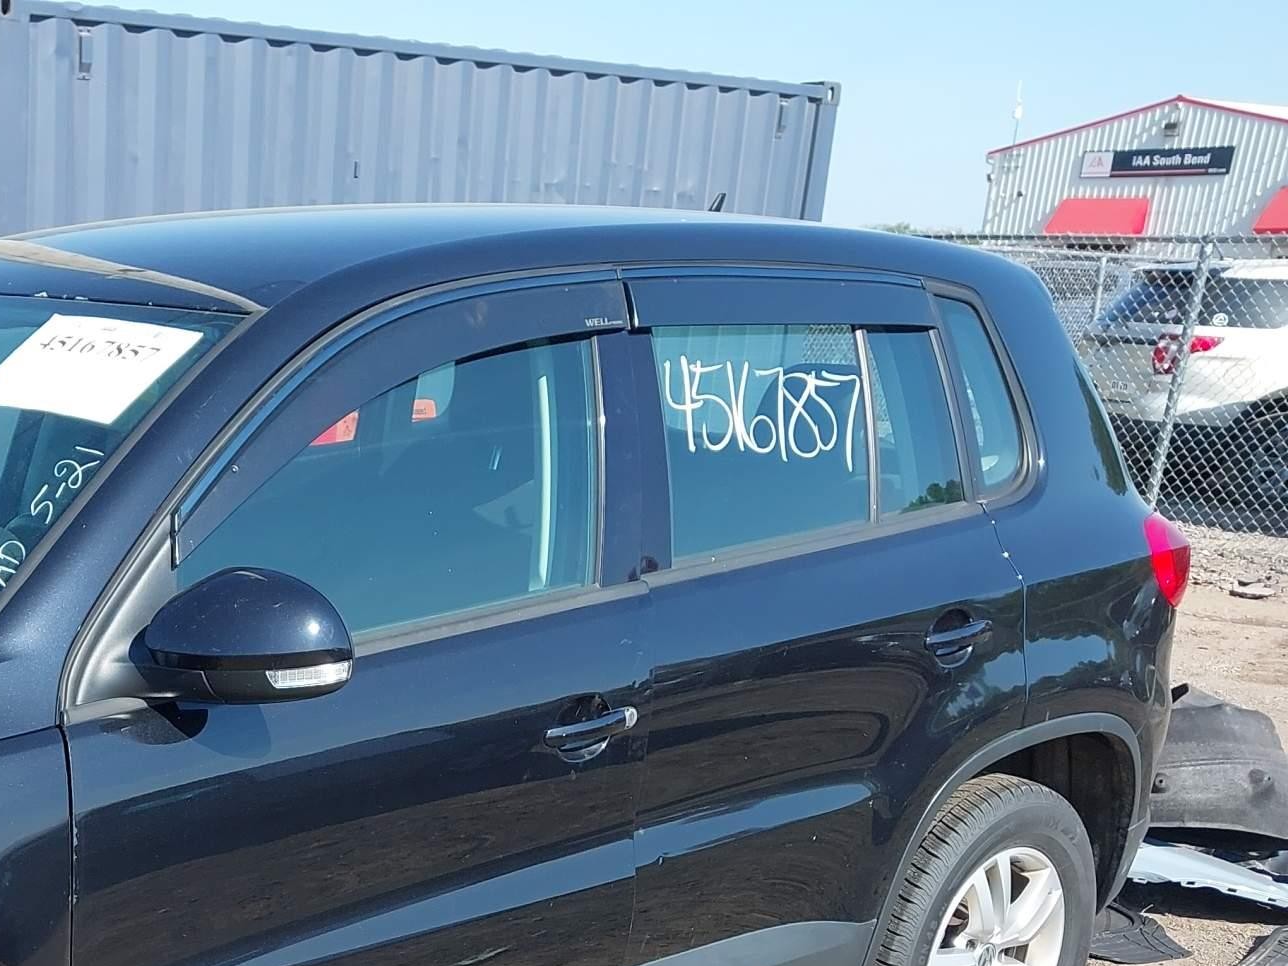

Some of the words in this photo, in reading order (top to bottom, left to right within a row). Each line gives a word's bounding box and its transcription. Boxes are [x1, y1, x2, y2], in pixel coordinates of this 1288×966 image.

[1132, 156, 1150, 167] IAA
[1152, 154, 1182, 166] South
[1183, 152, 1211, 165] Bend
[663, 354, 861, 473] 45167857
[30, 445, 105, 525] 5-21
